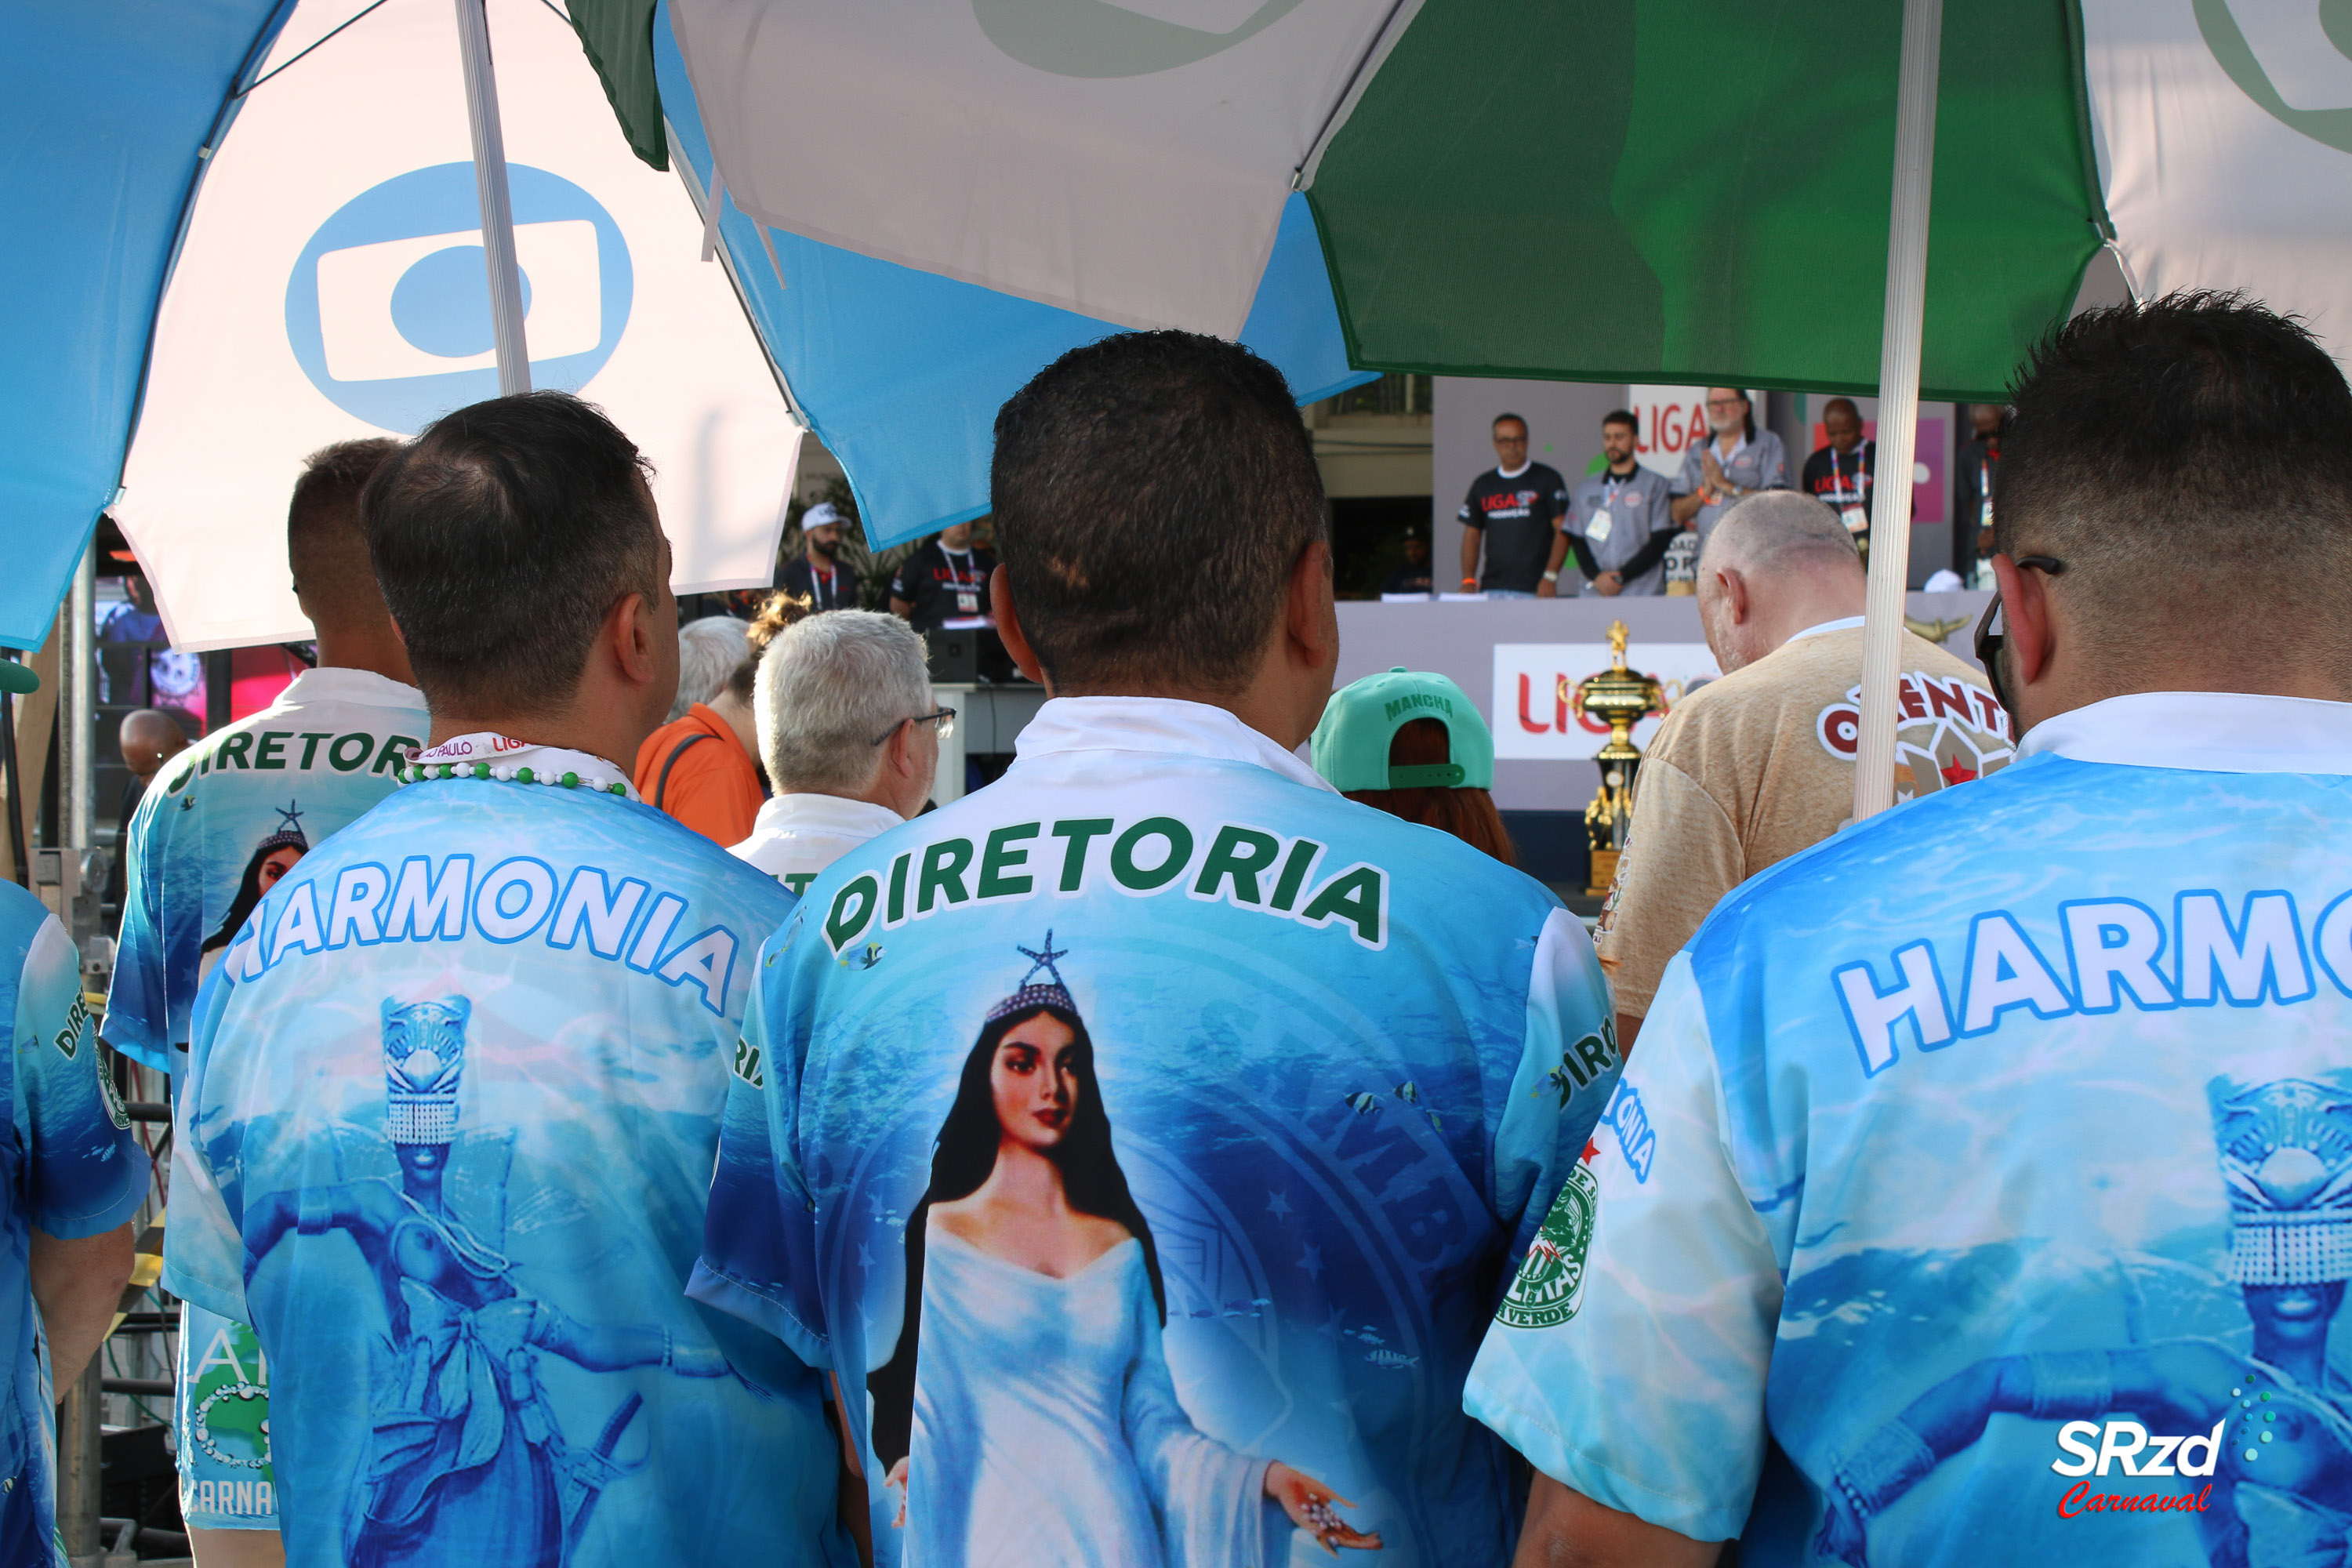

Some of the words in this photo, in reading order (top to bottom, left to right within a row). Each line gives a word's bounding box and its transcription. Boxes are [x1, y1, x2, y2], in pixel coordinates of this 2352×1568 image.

[1634, 403, 1708, 454] LIGA
[1384, 693, 1454, 722] MANCHA
[437, 741, 474, 758] PAULO
[824, 815, 1383, 953] DIRETORIA
[734, 1037, 764, 1088] RI
[1601, 1079, 1656, 1182] ONIA
[1508, 1301, 1574, 1326] VERDE
